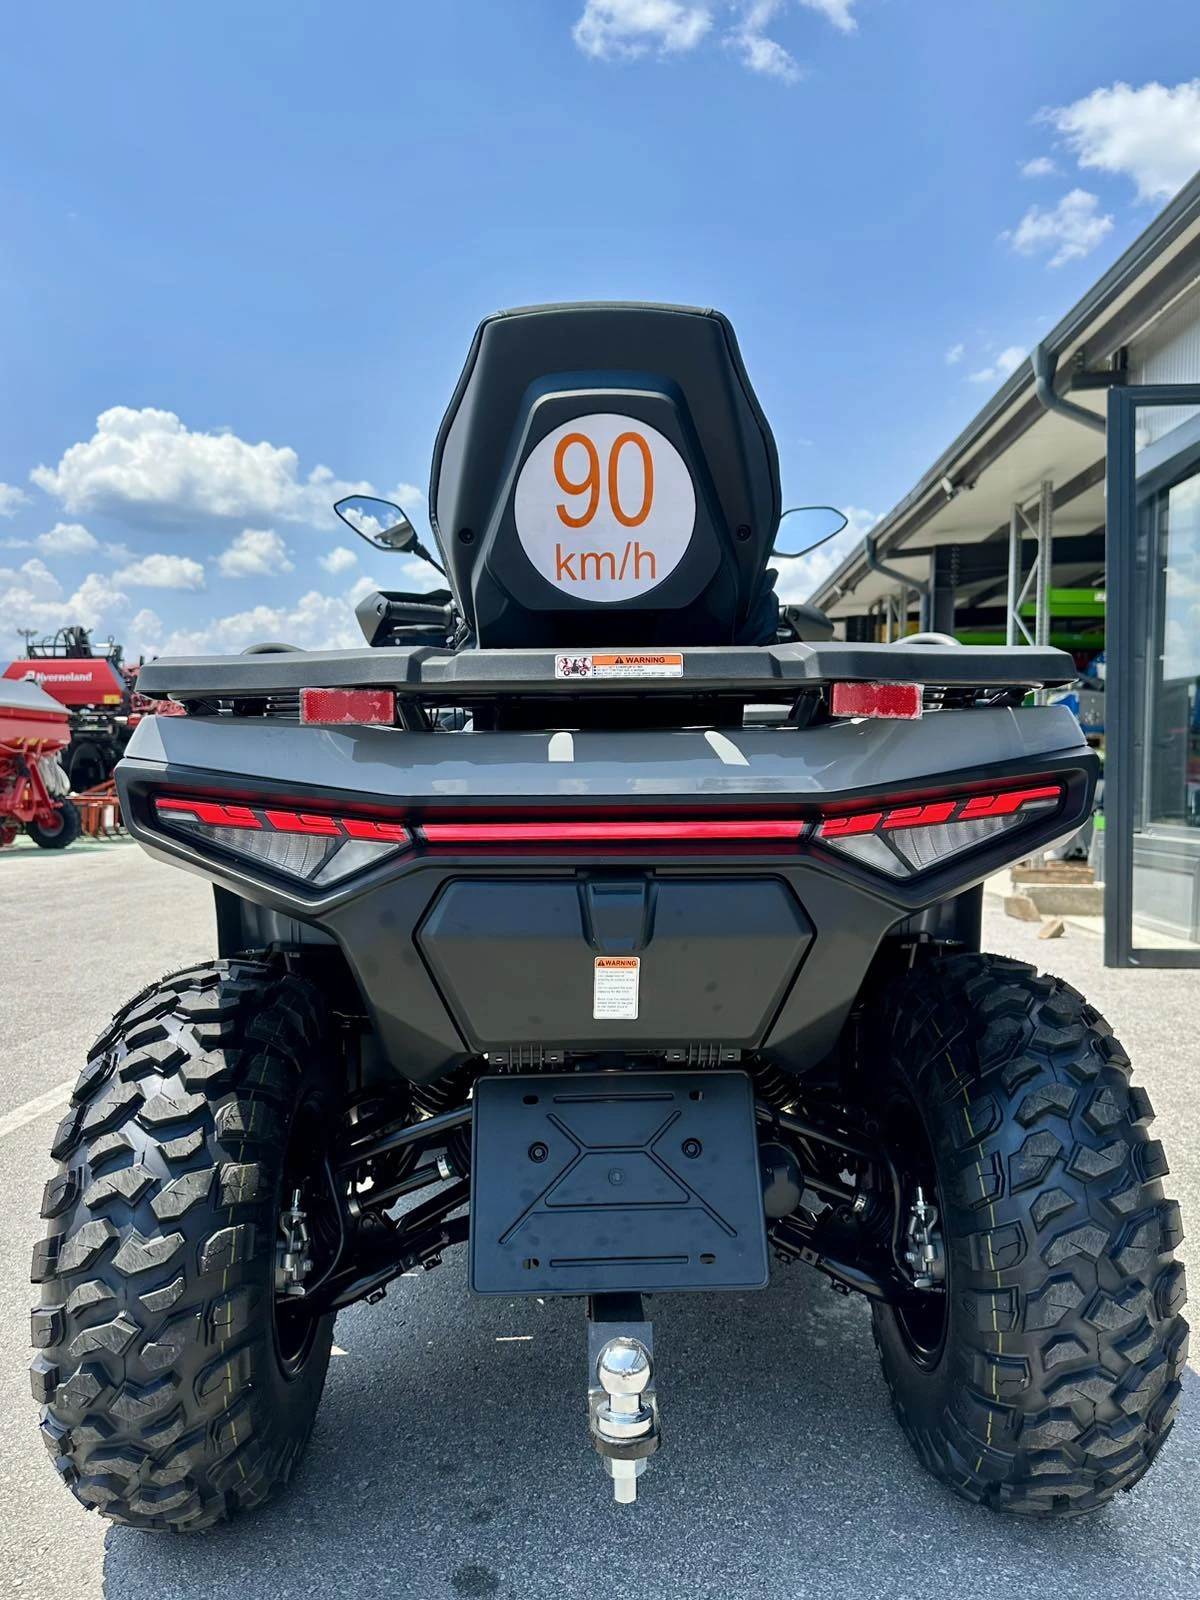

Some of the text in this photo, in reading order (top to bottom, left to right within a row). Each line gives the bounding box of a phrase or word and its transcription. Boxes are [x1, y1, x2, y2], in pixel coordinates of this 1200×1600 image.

[553, 431, 655, 529] 90
[555, 541, 656, 581] km/h
[626, 656, 666, 664] WARNING
